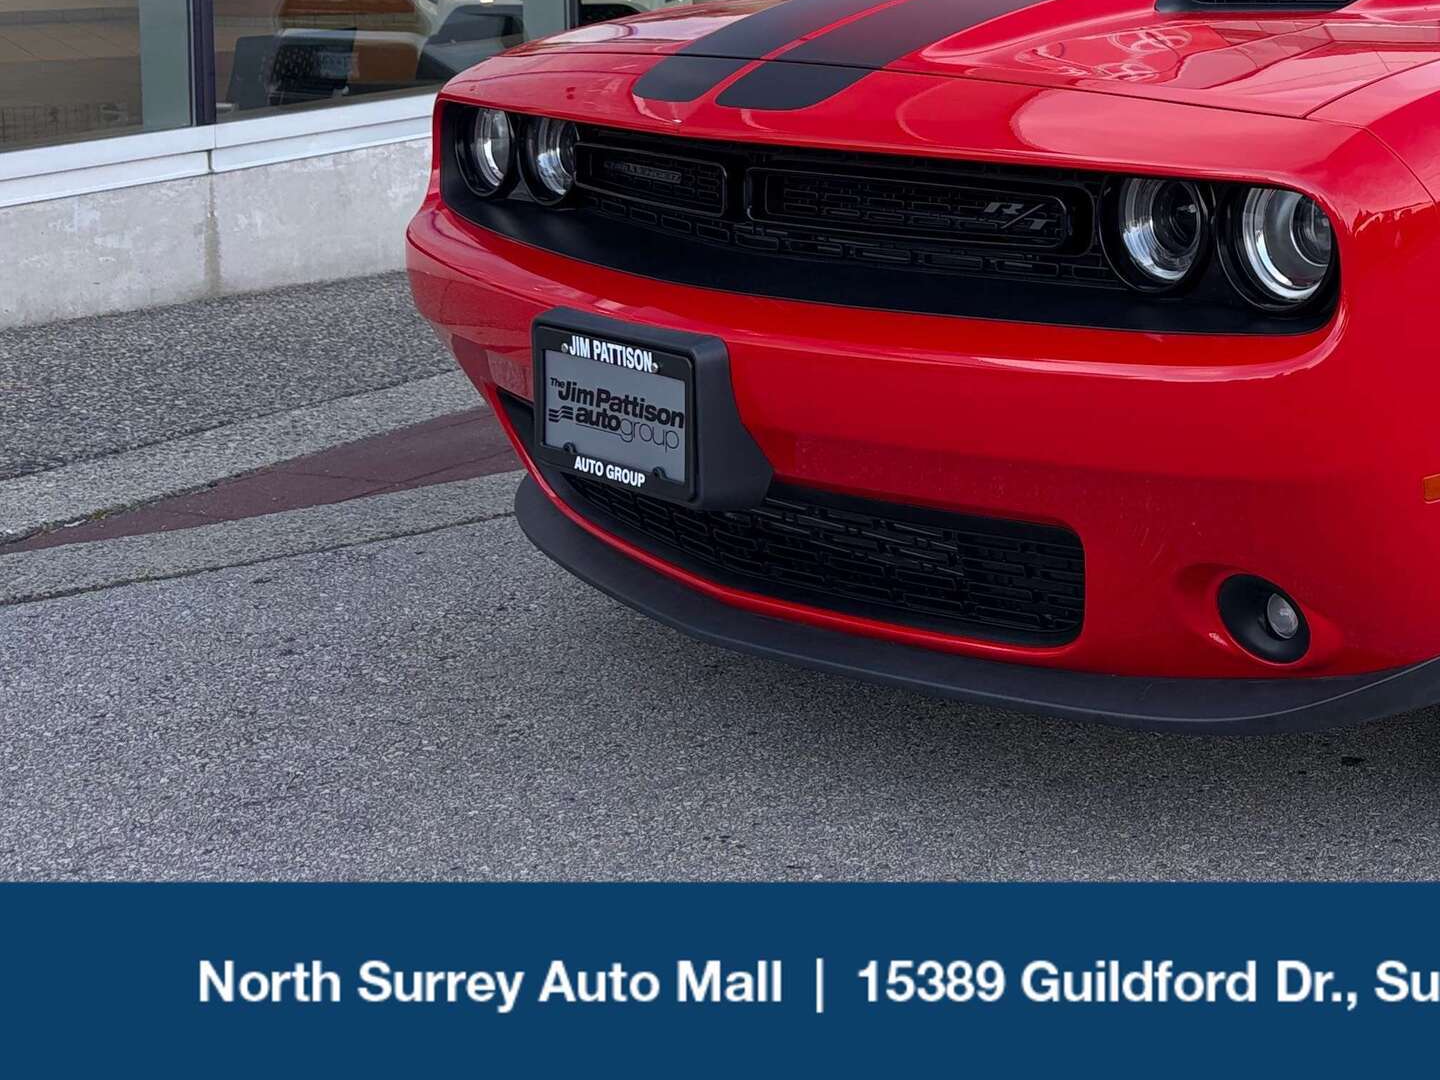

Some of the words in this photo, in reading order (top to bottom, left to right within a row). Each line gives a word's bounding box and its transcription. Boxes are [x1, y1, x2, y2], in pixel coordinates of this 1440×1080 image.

[569, 335, 590, 359] JIM
[593, 339, 653, 373] PATTISON
[550, 376, 565, 388] The
[574, 455, 604, 476] AUTO
[606, 465, 646, 487] GROUP
